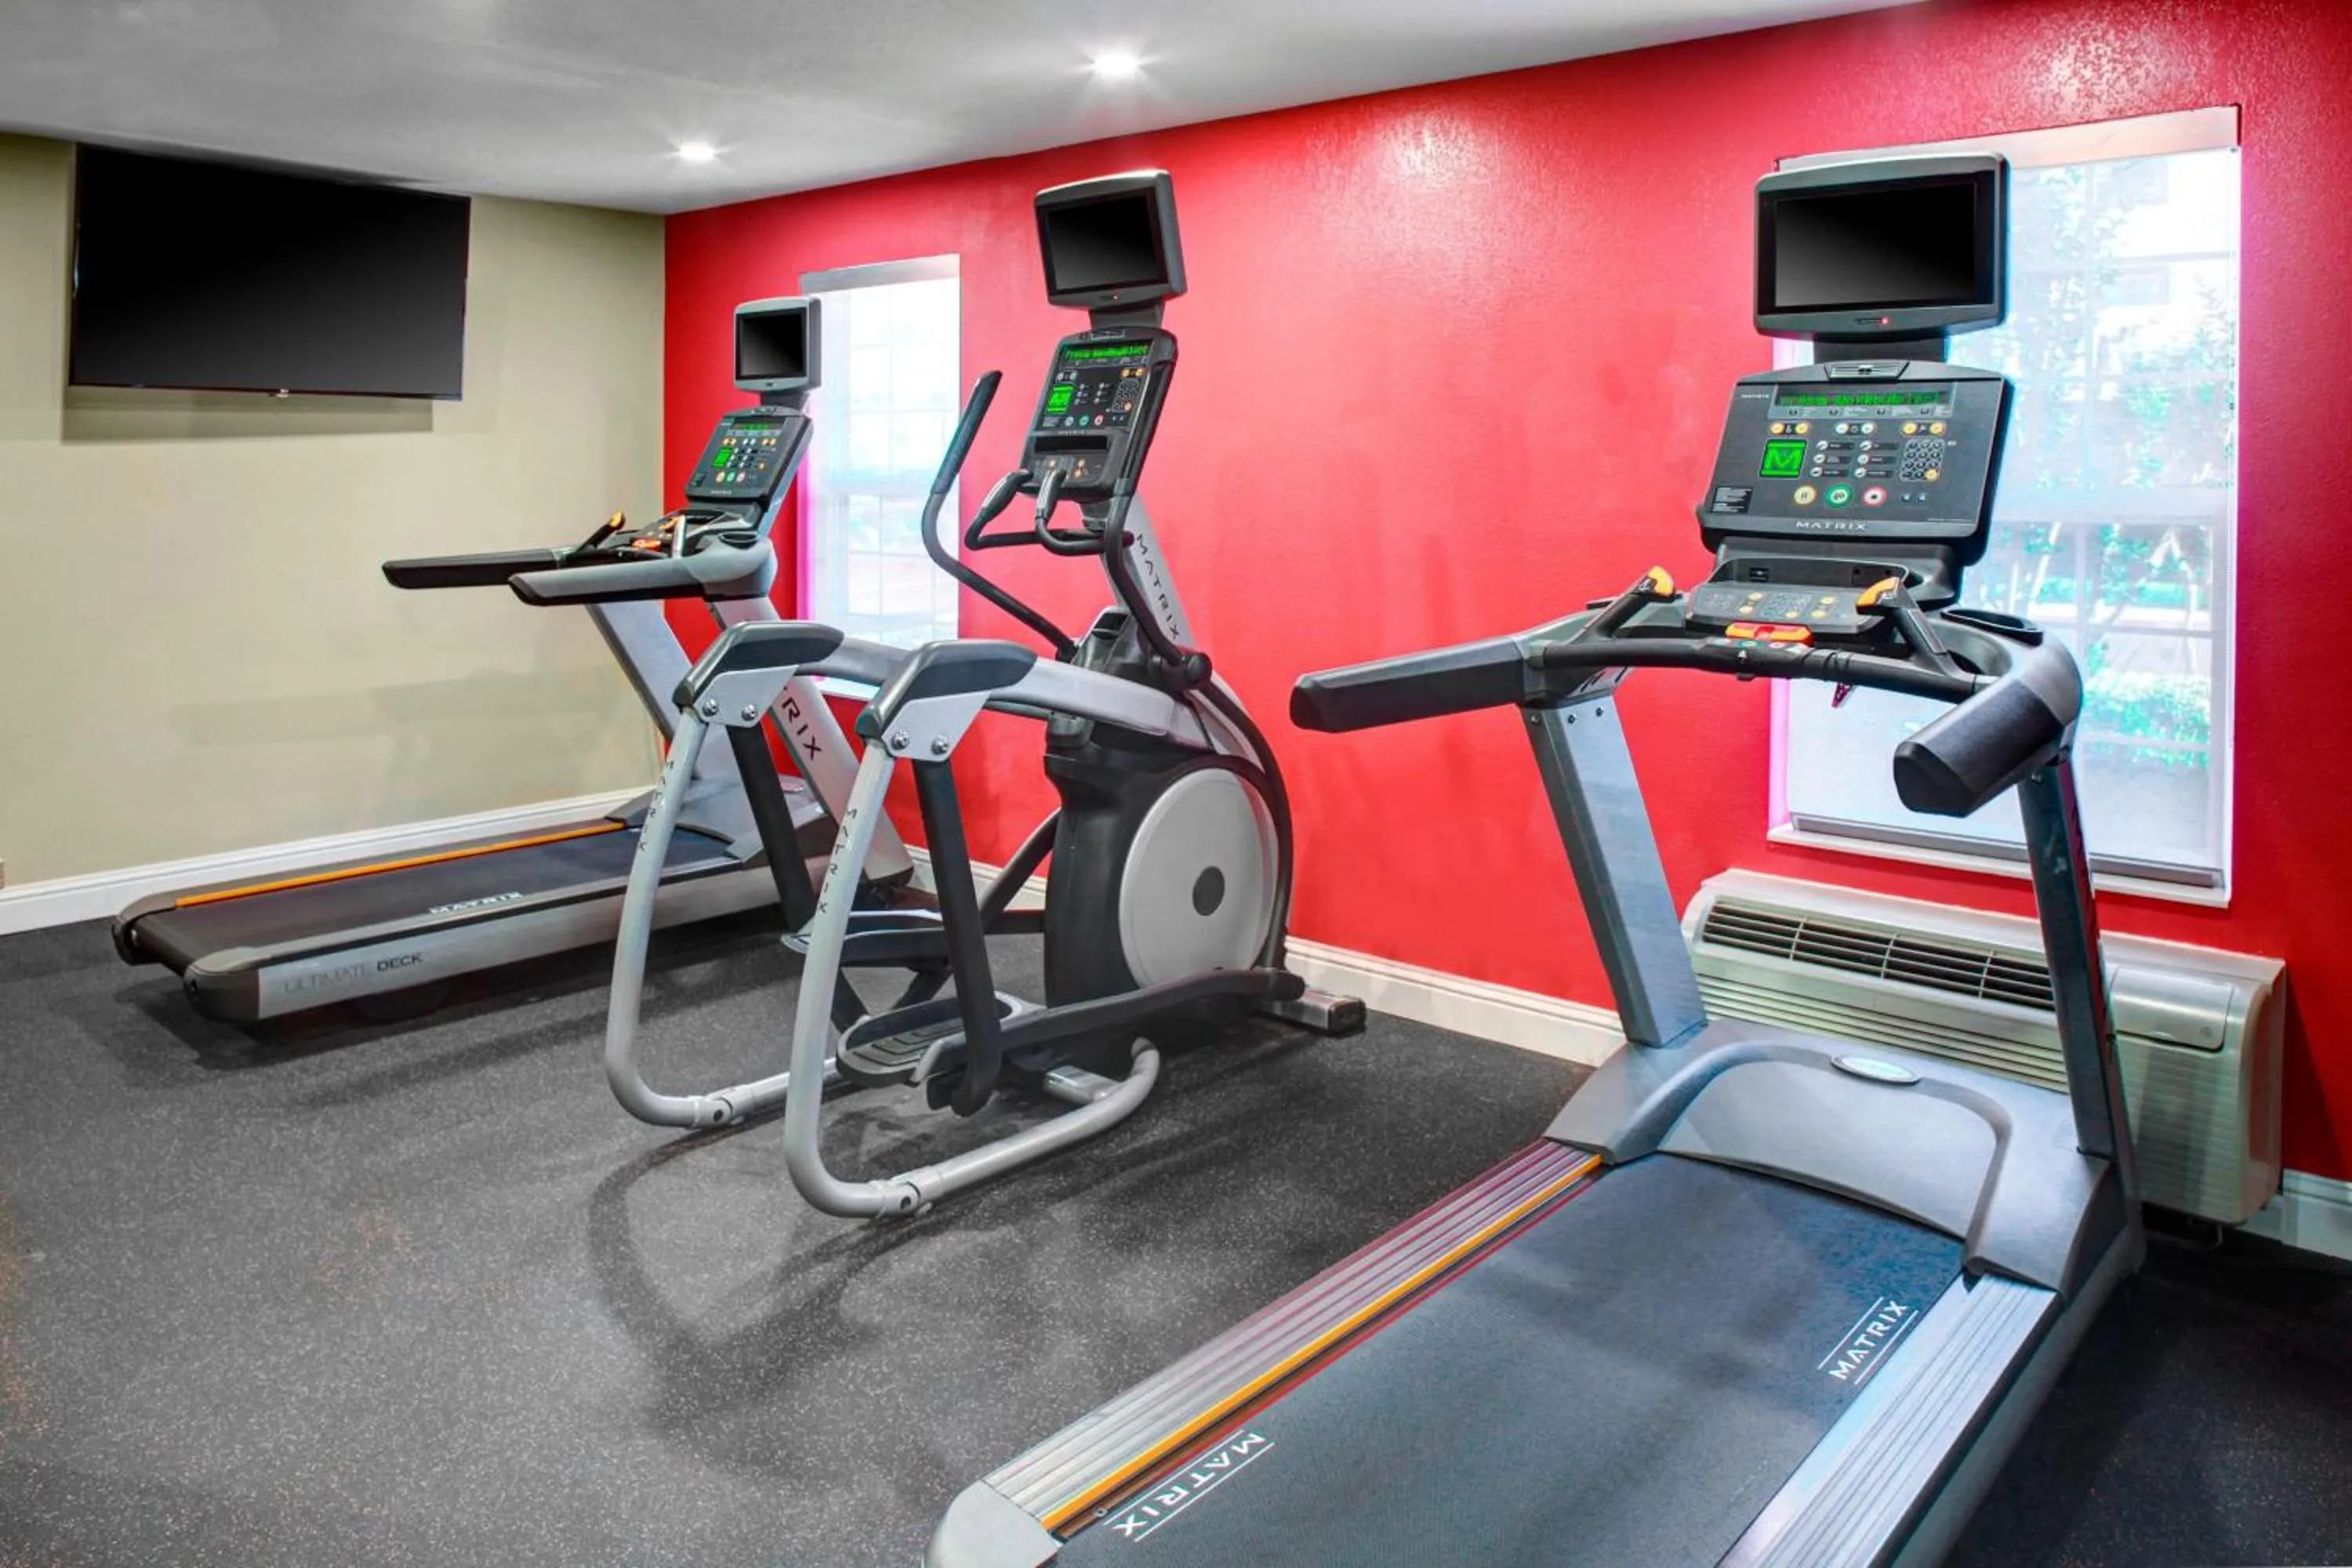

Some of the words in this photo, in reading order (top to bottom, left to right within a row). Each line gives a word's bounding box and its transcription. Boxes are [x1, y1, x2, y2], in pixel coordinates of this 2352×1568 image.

[1796, 521, 1867, 532] MATRIX
[1137, 532, 1180, 640] MATRIX
[781, 686, 823, 761] RIX
[376, 953, 424, 972] DECK
[1828, 1300, 1908, 1380] MATRIX
[1112, 1432, 1267, 1537] MATRIX
